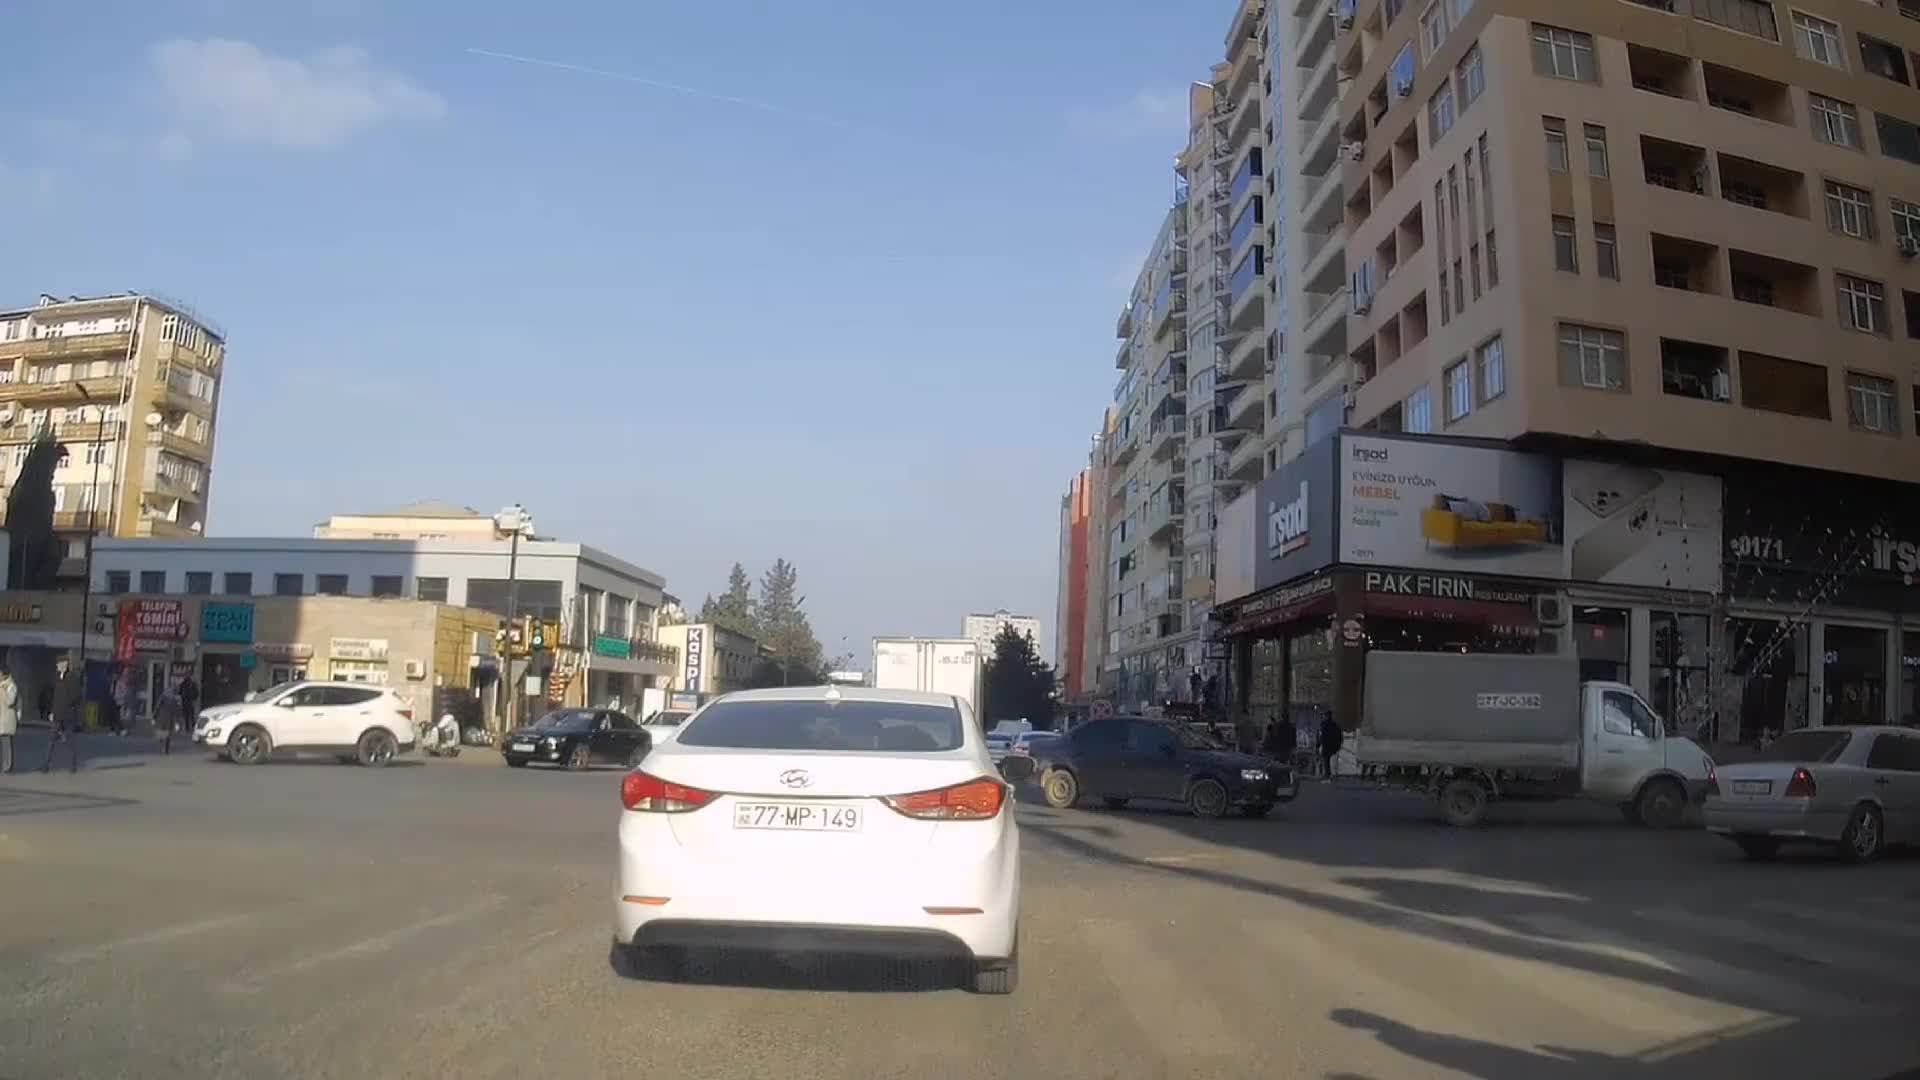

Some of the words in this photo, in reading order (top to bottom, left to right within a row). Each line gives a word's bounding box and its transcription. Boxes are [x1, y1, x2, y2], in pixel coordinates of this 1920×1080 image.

[1352, 485, 1400, 500] MEBEL
[1365, 571, 1412, 594] PAK
[1416, 576, 1473, 599] FIRIN
[753, 805, 857, 828] 77-MP-149
